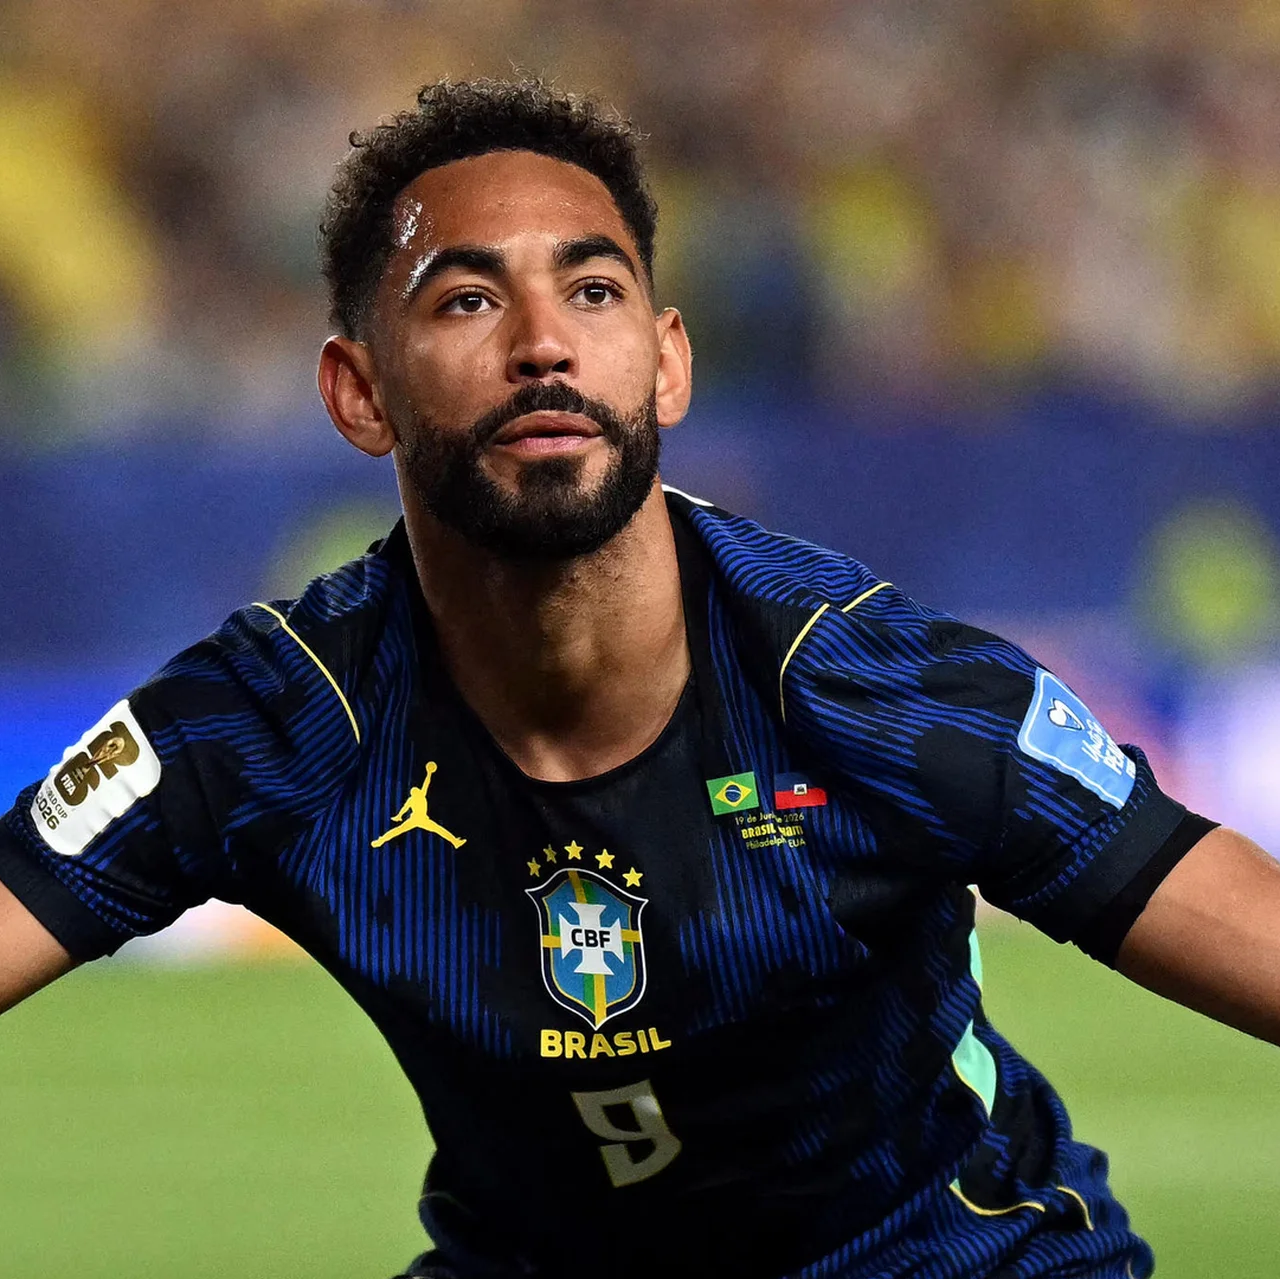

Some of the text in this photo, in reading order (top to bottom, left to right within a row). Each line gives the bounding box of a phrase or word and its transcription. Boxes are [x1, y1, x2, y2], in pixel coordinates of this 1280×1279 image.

[60, 773, 77, 796] FIFA
[35, 791, 60, 830] 2026
[54, 802, 68, 818] CUP
[734, 816, 744, 825] 19
[747, 814, 757, 823] de
[783, 812, 805, 823] 2026
[787, 838, 807, 848] EUA
[571, 928, 611, 949] CBF
[540, 1027, 672, 1060] BRASIL
[571, 1079, 683, 1188] 9
